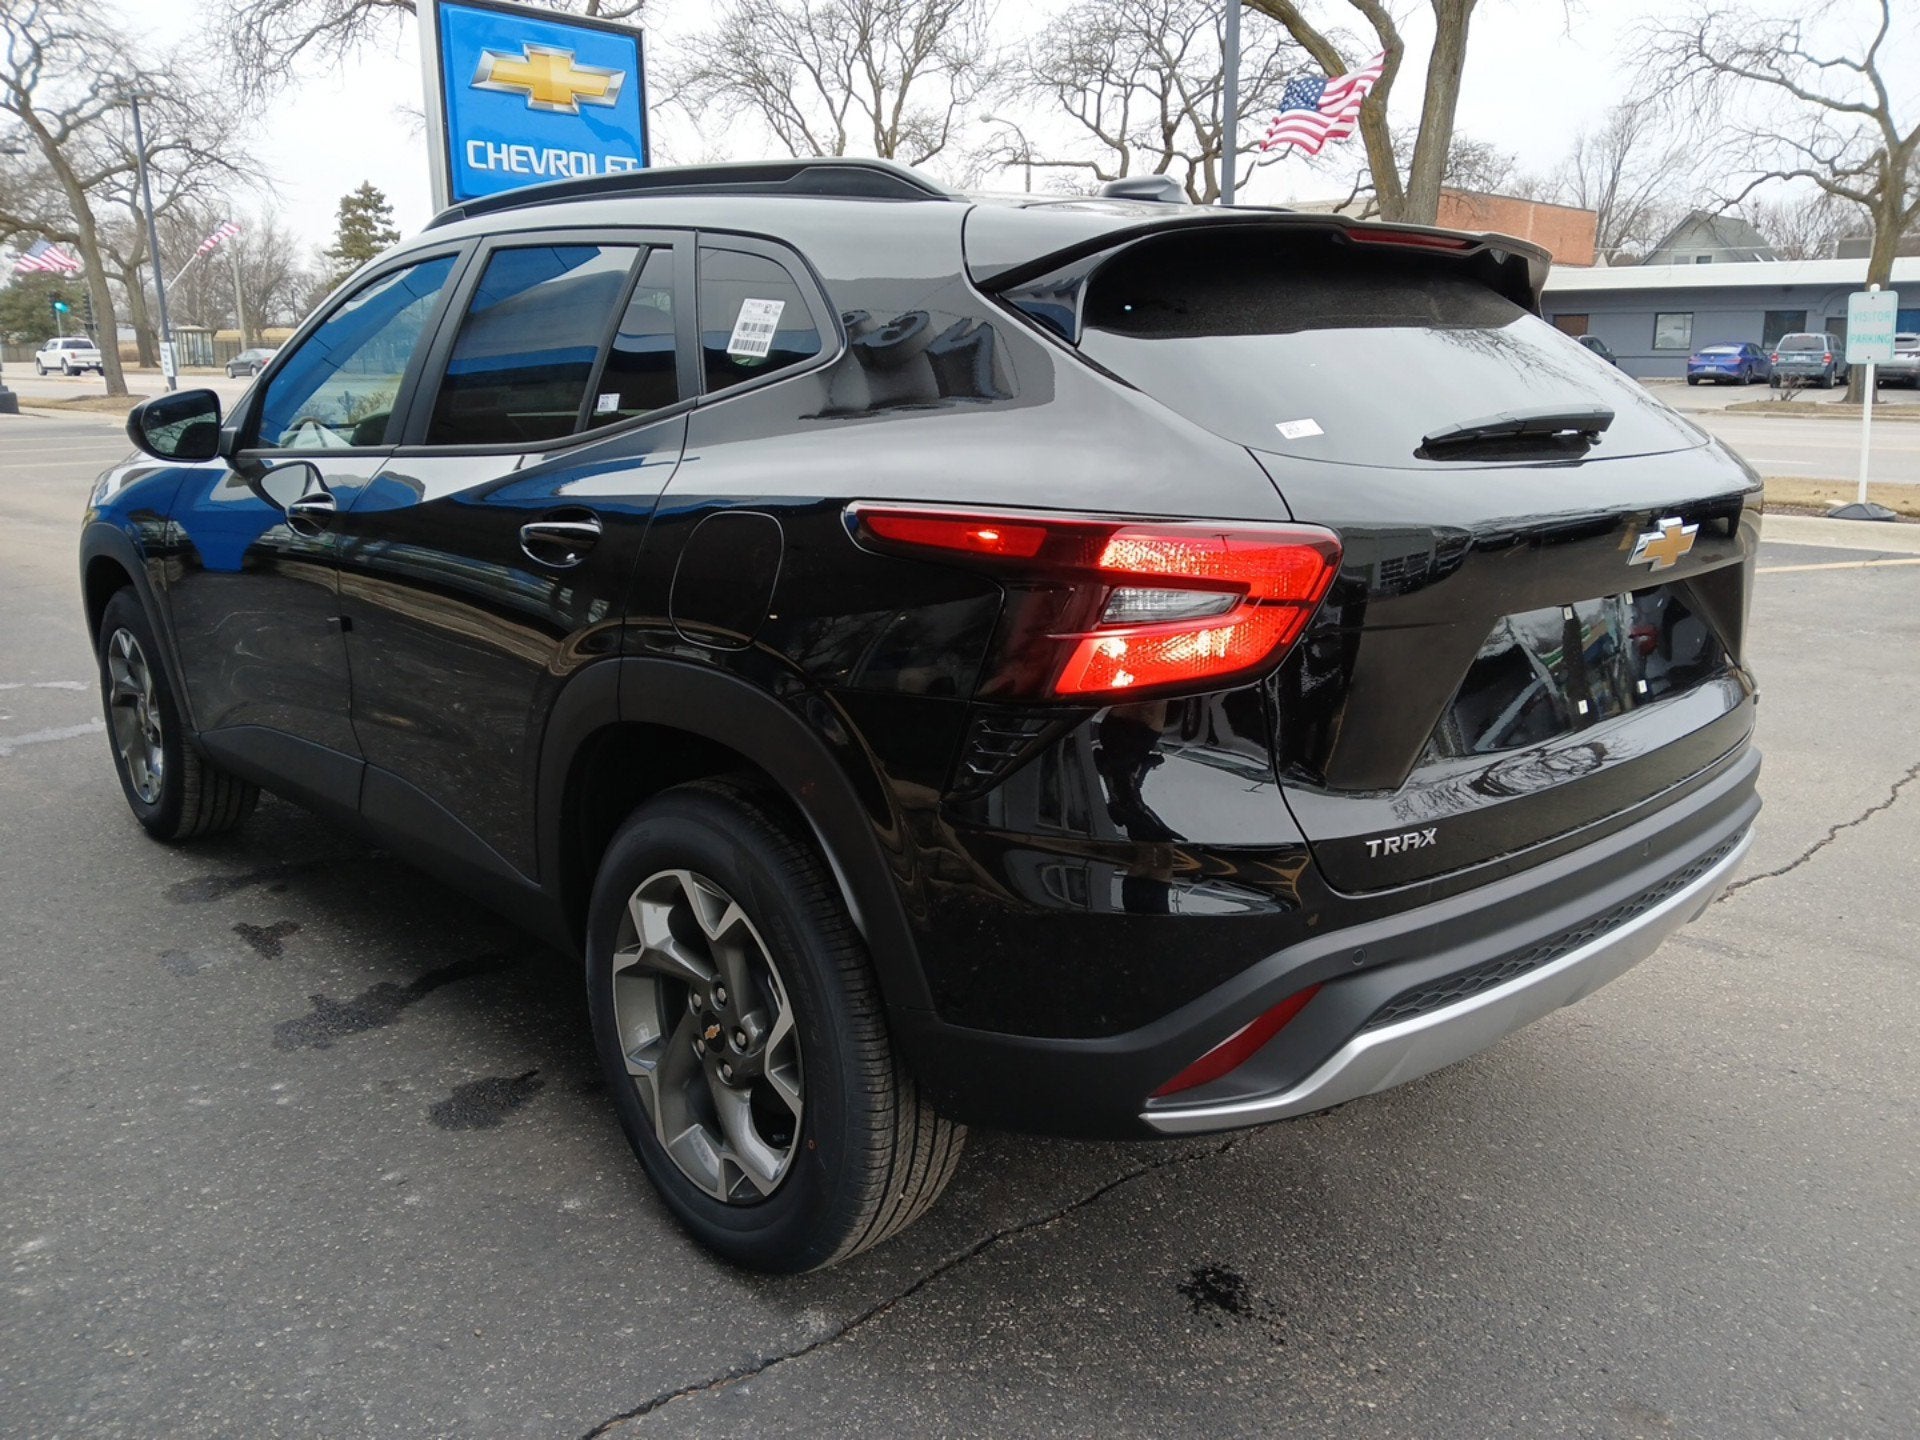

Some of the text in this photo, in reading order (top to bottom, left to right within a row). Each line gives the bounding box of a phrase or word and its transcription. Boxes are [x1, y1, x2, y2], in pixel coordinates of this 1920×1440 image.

[1851, 310, 1891, 322] VISITOR
[1849, 333, 1891, 344] PARKING
[1365, 828, 1437, 857] TRAX
